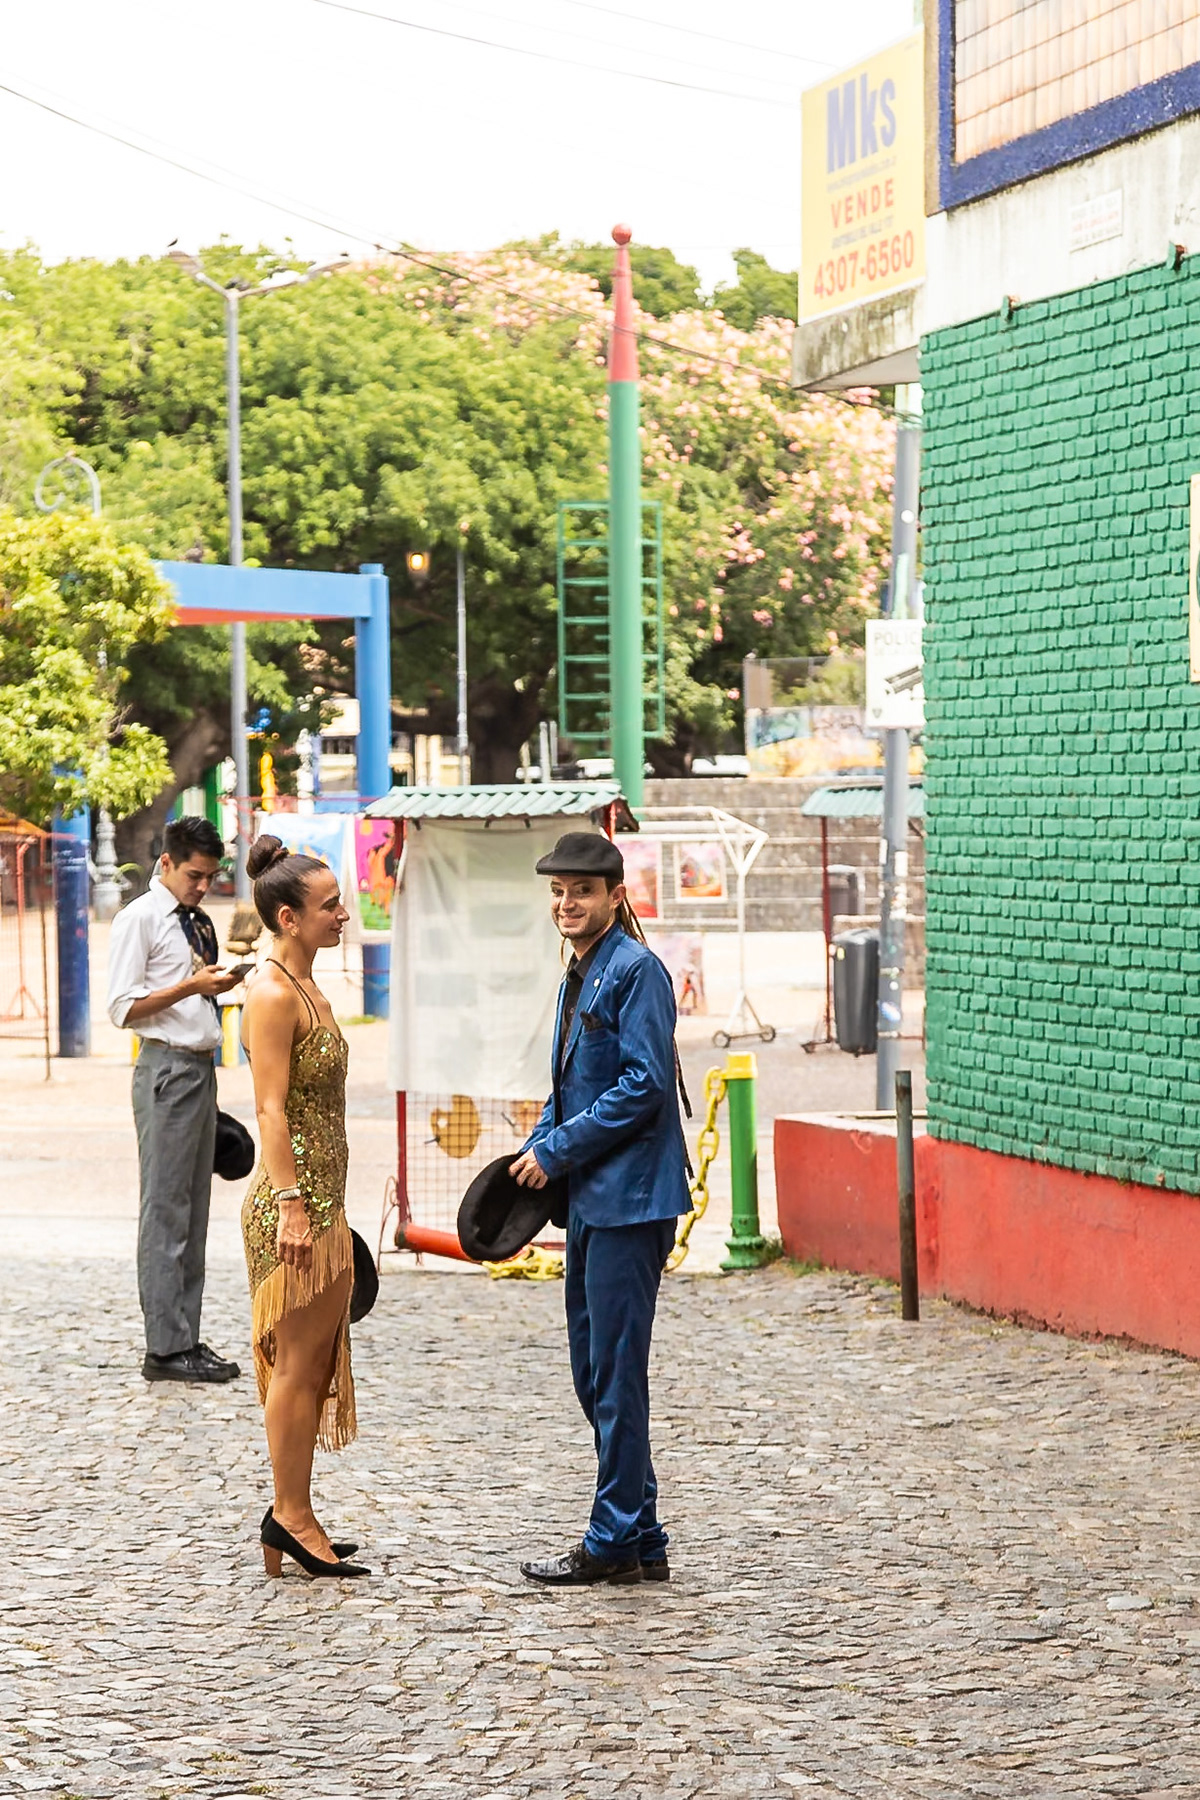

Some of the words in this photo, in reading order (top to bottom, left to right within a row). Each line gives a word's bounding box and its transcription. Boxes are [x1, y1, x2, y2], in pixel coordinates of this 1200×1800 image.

[826, 73, 897, 174] Mks
[831, 178, 894, 229] VENDE
[813, 231, 914, 300] 4307-6560
